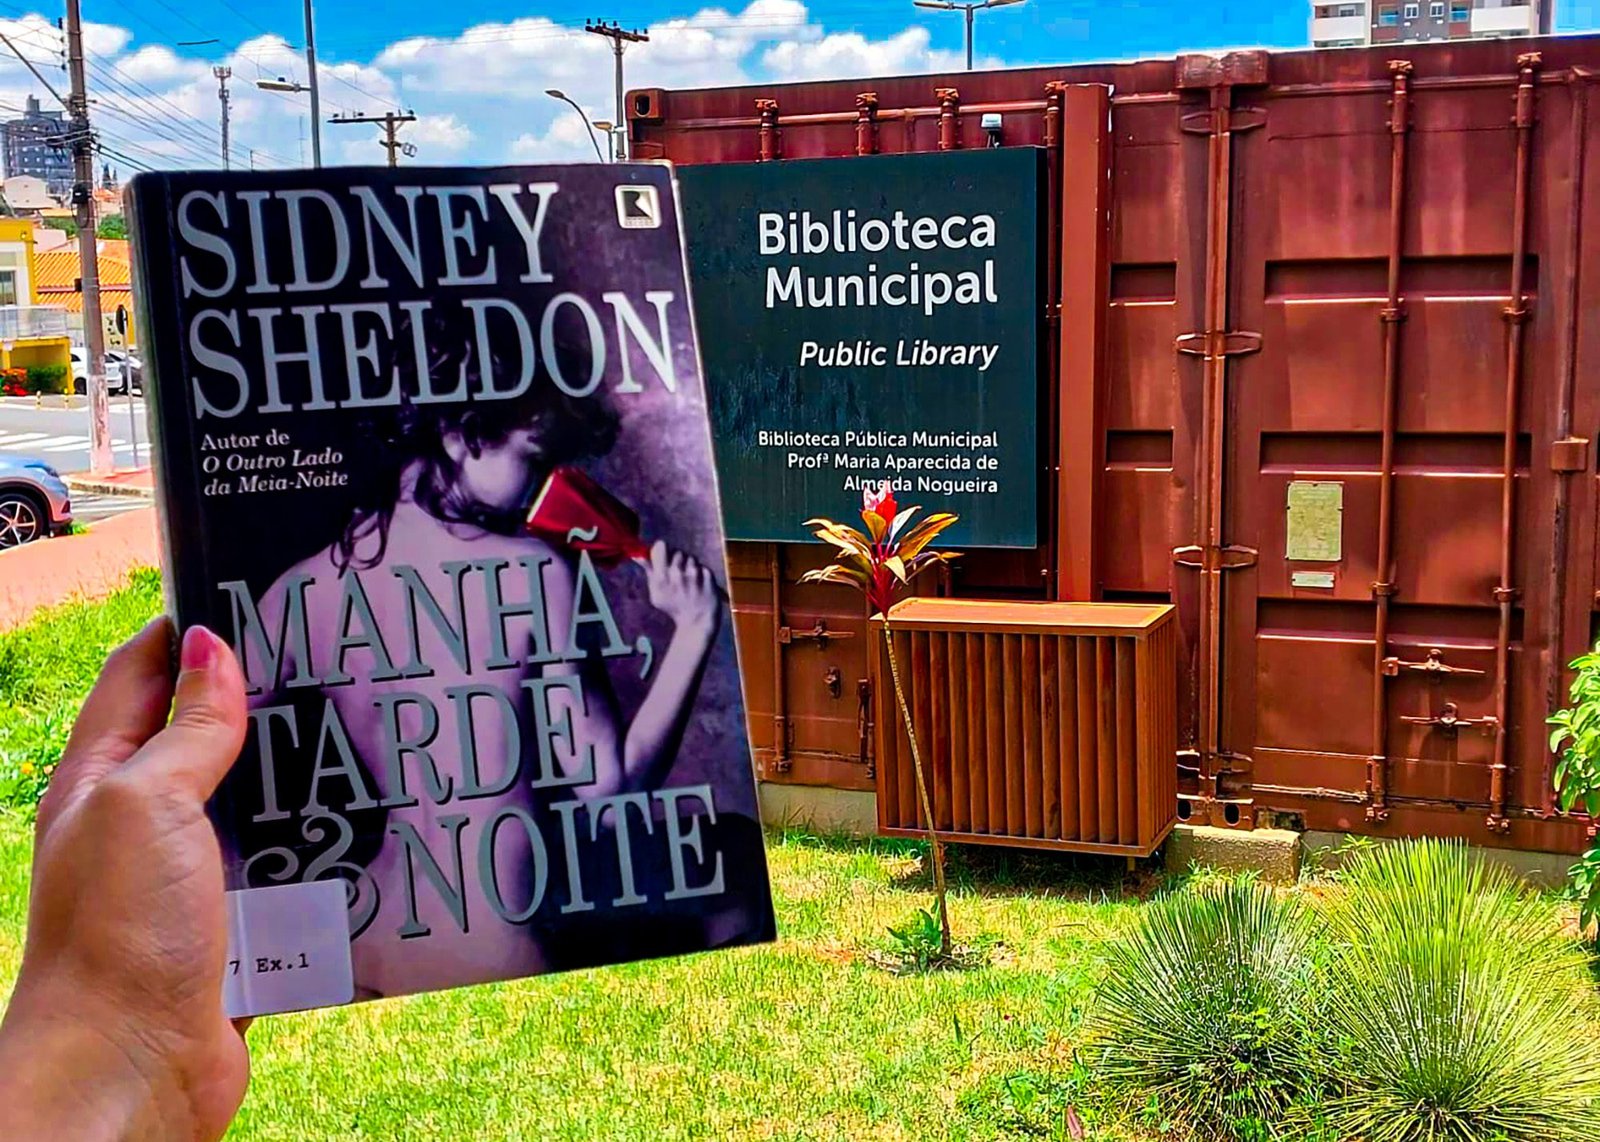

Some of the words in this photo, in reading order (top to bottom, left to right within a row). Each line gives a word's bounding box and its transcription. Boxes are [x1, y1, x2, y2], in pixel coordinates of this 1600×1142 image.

[177, 182, 559, 298] SIDNEY
[758, 209, 996, 255] Biblioteca
[765, 260, 998, 315] Municipal
[189, 291, 676, 419] SHELDON
[800, 341, 887, 367] Public
[896, 340, 999, 371] Library
[200, 433, 260, 450] Autor
[265, 428, 290, 446] de
[758, 431, 840, 447] Biblioteca
[845, 431, 907, 447] Pública
[912, 431, 998, 450] Municipal
[202, 456, 220, 473] O
[226, 454, 286, 471] Outro
[291, 447, 343, 467] Lado
[834, 453, 880, 469] Maria
[884, 454, 971, 473] Aparecida
[976, 455, 998, 470] de
[203, 478, 231, 496] da
[237, 471, 348, 493] Meia-Noite
[917, 476, 998, 495] Nogueira
[217, 525, 655, 694] MANHÃ,
[247, 674, 596, 822] TARDE
[391, 785, 725, 938] NOITE
[256, 953, 309, 973] Ex.1
